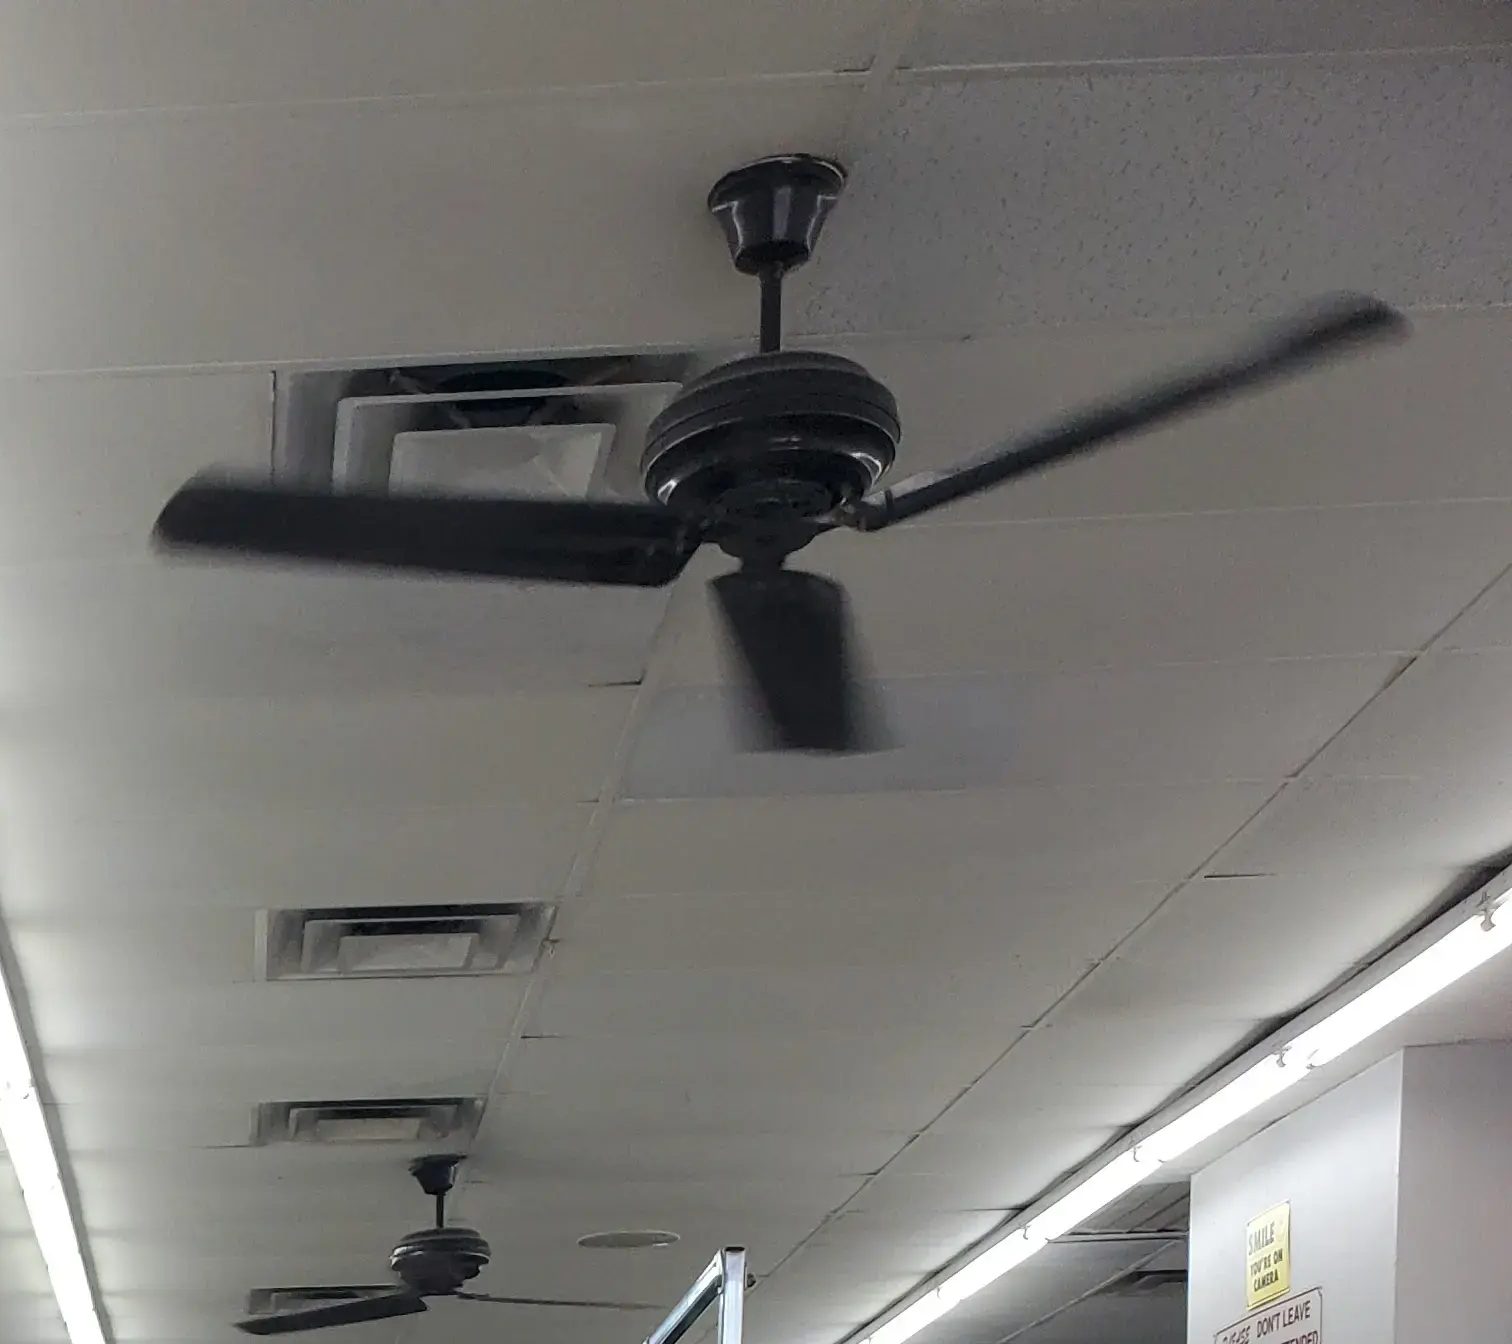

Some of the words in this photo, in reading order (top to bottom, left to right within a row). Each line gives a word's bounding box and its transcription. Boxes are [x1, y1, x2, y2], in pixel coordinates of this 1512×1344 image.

[1248, 1222, 1275, 1255] SMILE
[1250, 1252, 1272, 1277] YOU'RE
[1274, 1247, 1283, 1264] ON
[1253, 1269, 1279, 1293] CAMERA
[1256, 1311, 1282, 1339] DON'T
[1282, 1299, 1311, 1328] LEAVE
